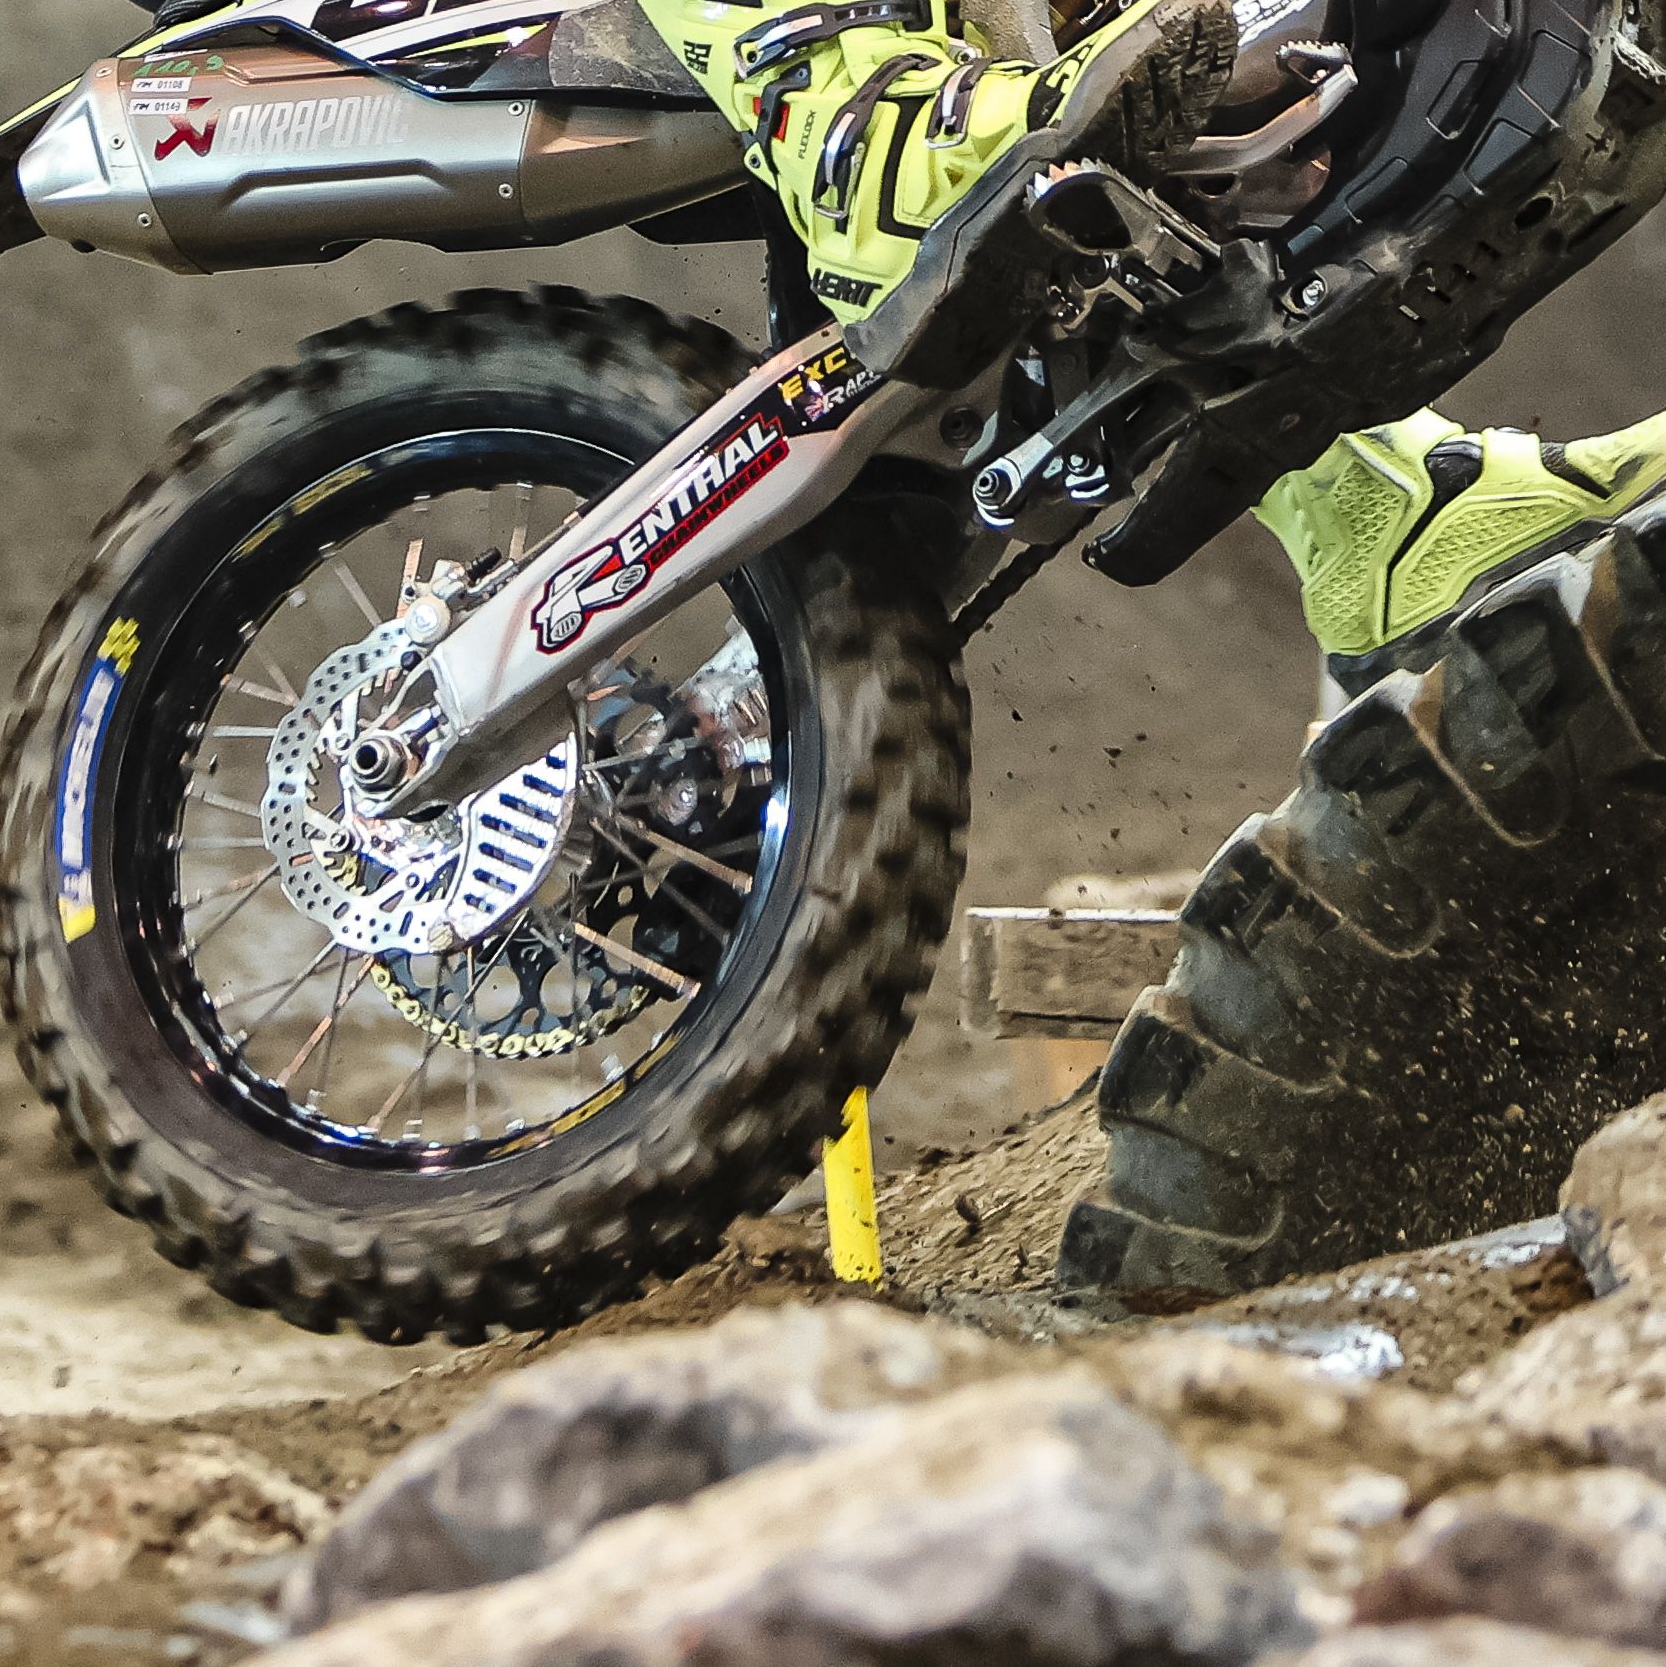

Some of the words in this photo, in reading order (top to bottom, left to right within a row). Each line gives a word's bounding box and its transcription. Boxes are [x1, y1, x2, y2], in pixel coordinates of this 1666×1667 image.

[781, 346, 848, 402] EXC
[821, 370, 875, 415] RAP
[535, 422, 779, 648] RENTHAL
